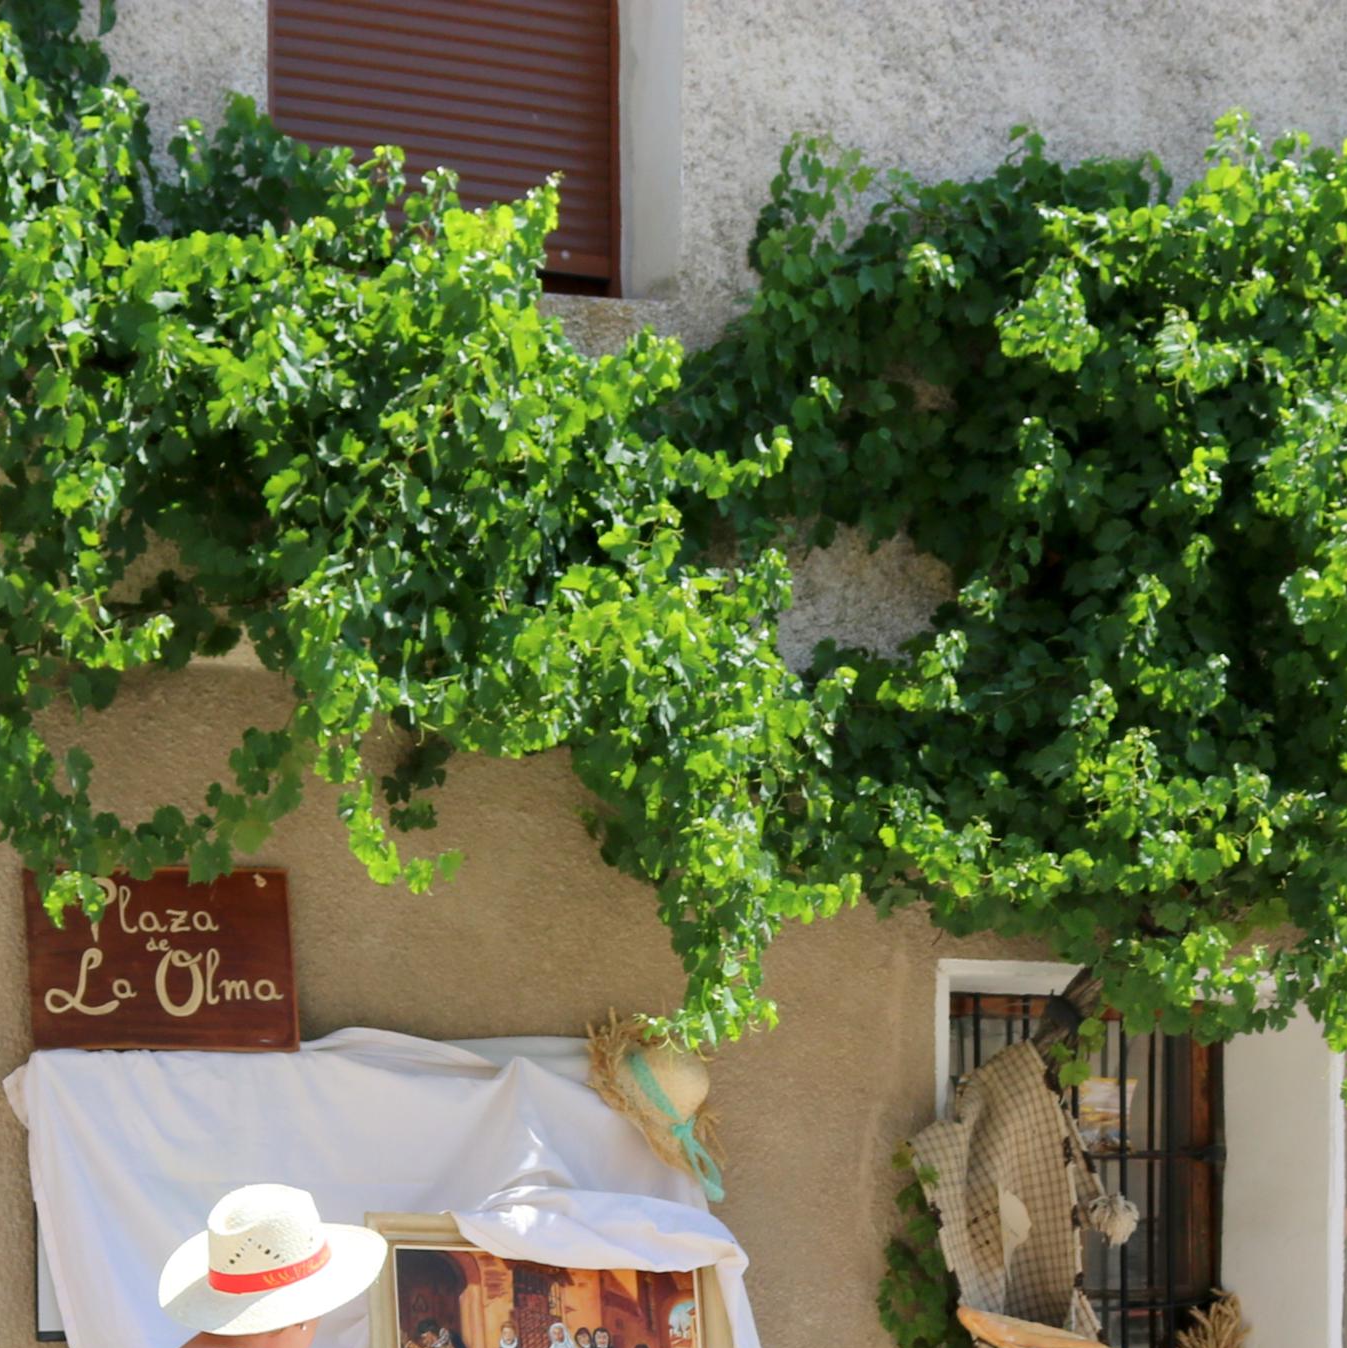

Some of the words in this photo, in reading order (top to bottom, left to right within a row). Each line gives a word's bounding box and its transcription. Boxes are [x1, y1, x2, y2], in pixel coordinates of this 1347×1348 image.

[145, 937, 171, 951] de
[44, 948, 137, 1015] La
[155, 948, 284, 1017] Olma
